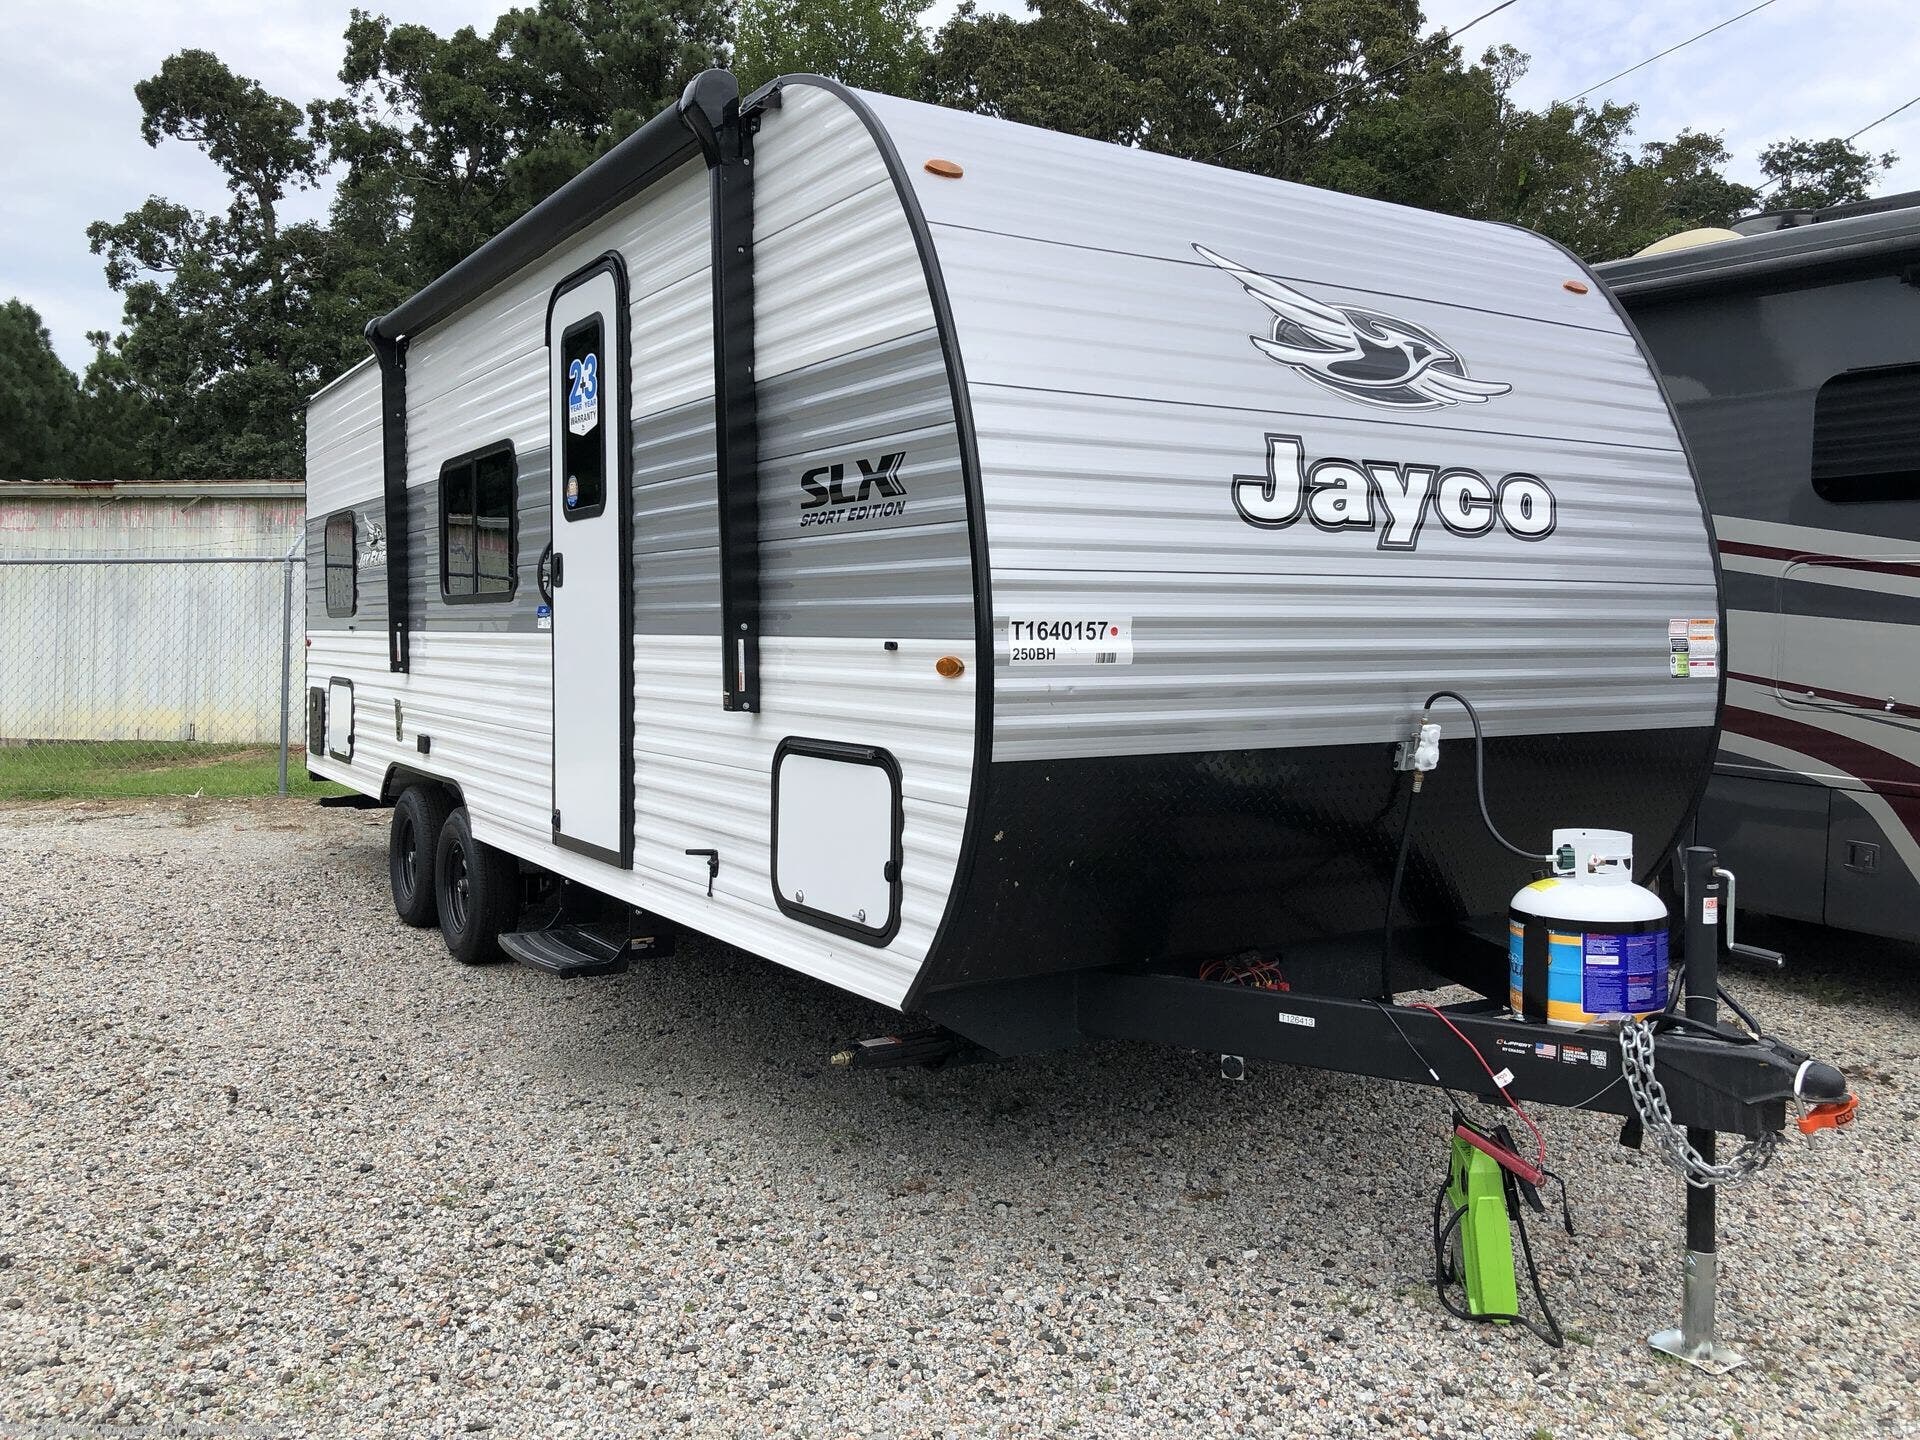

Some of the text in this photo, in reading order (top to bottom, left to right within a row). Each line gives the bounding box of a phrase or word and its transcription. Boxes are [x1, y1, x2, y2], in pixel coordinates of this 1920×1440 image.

[571, 399, 597, 413] YEAR YEAR
[570, 410, 597, 425] WARRANTY
[800, 452, 907, 509] SLX
[1231, 432, 1556, 551] Jayco
[800, 500, 906, 527] SPORT EDITION
[1011, 621, 1108, 640] T1640157
[1012, 648, 1056, 660] 250BH
[1281, 1013, 1314, 1026] T126413
